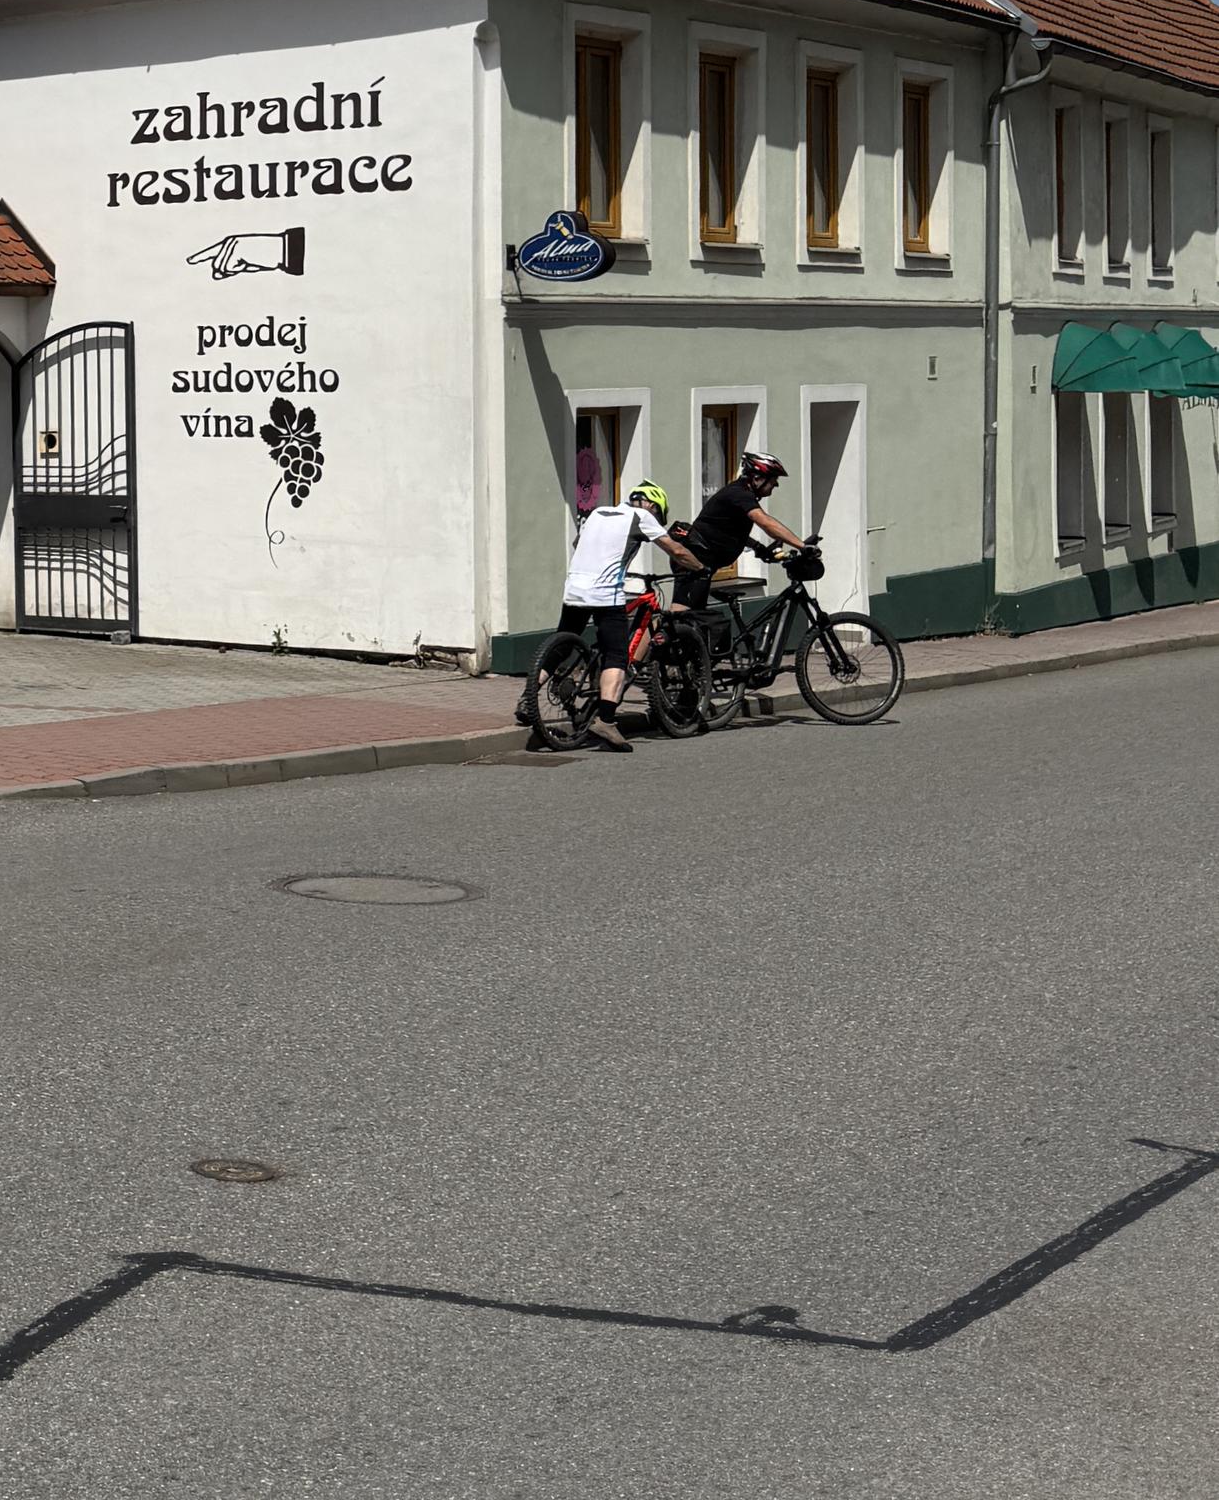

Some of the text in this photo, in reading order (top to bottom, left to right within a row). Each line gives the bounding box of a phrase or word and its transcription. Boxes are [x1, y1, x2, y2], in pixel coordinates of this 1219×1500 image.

[130, 76, 386, 145] zahradní
[107, 154, 413, 208] restaurace
[196, 315, 308, 356] prodej
[171, 361, 340, 393] sudového
[180, 407, 255, 438] vína
